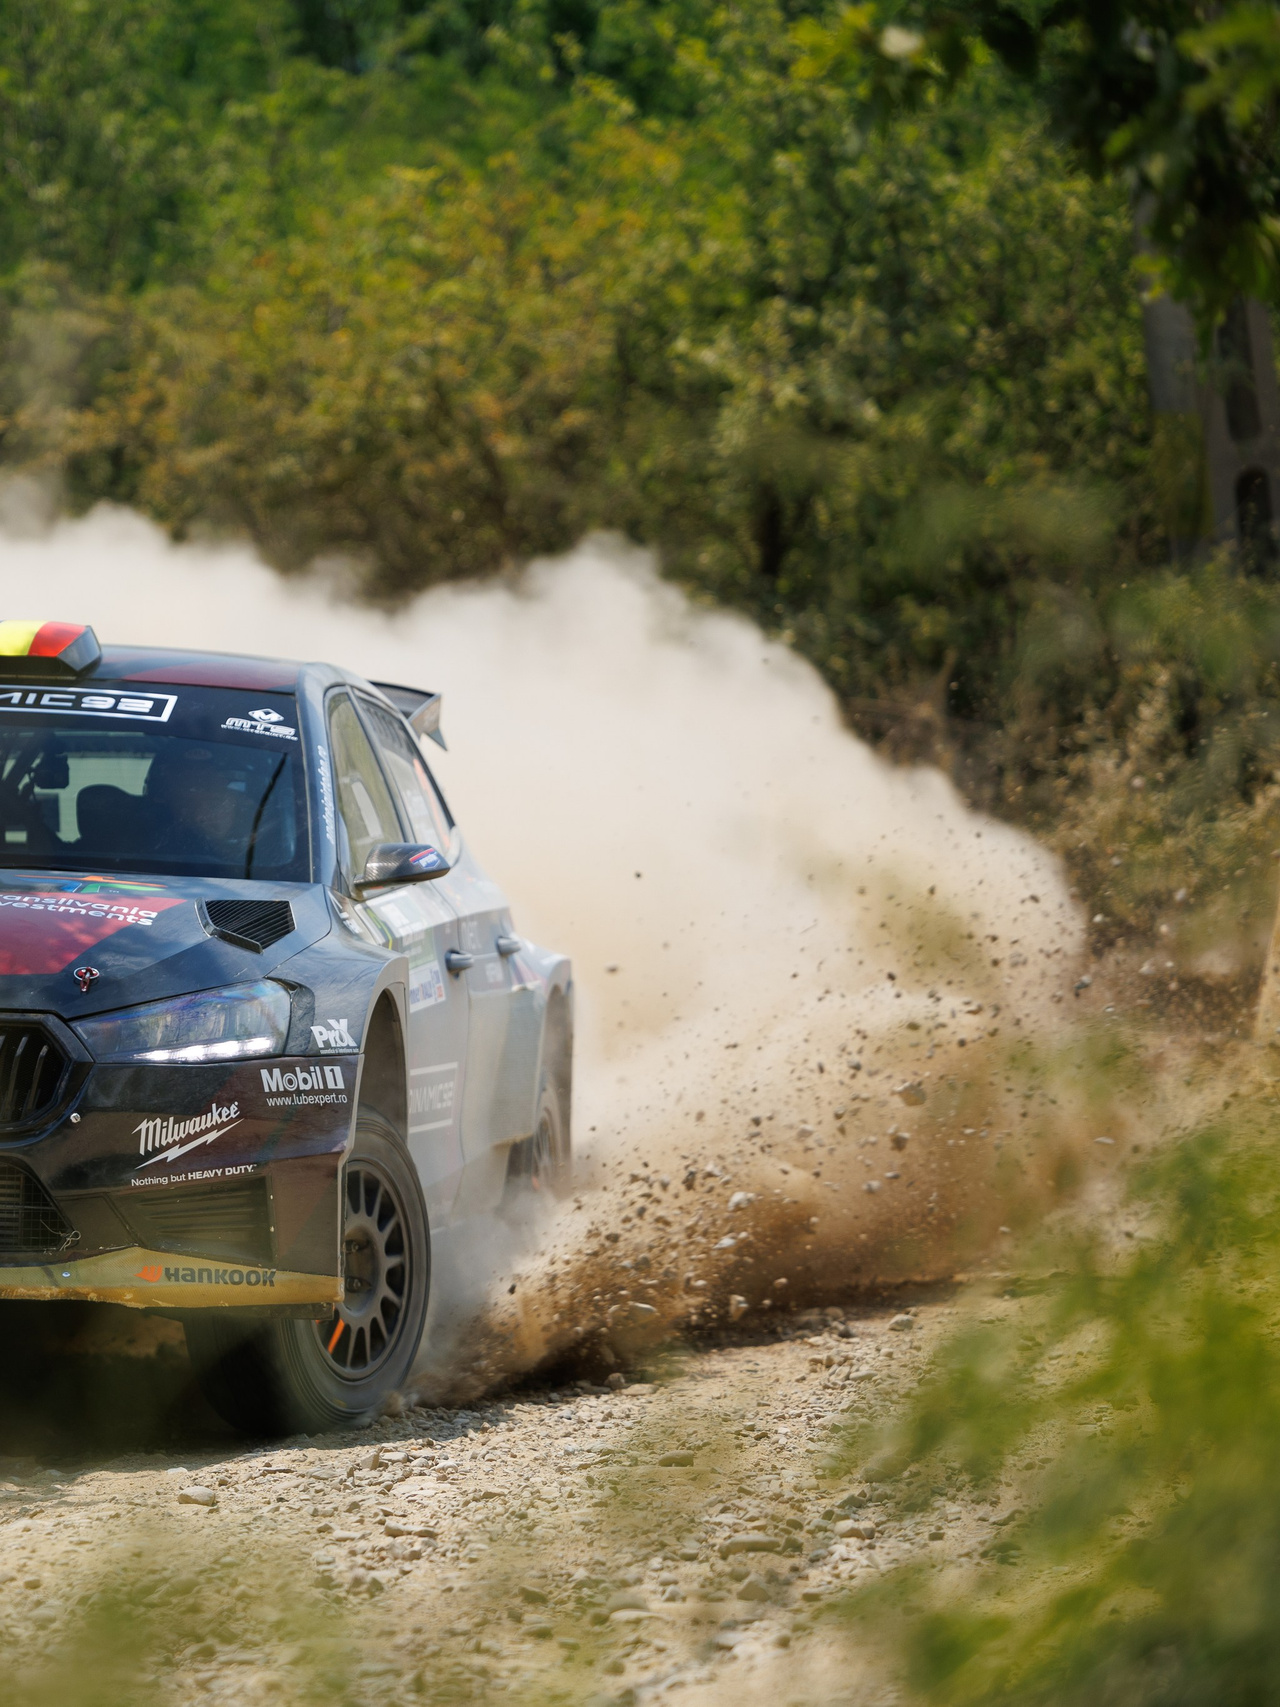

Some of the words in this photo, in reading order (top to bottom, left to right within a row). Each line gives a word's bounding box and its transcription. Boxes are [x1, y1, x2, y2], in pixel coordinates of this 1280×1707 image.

[260, 1066, 324, 1092] Mobil
[266, 1093, 348, 1107] www.lubexpert.ro
[131, 1101, 240, 1156] Milwaukee
[131, 1176, 169, 1187] Nothing
[170, 1173, 186, 1183] but
[188, 1168, 223, 1180] HEAVY
